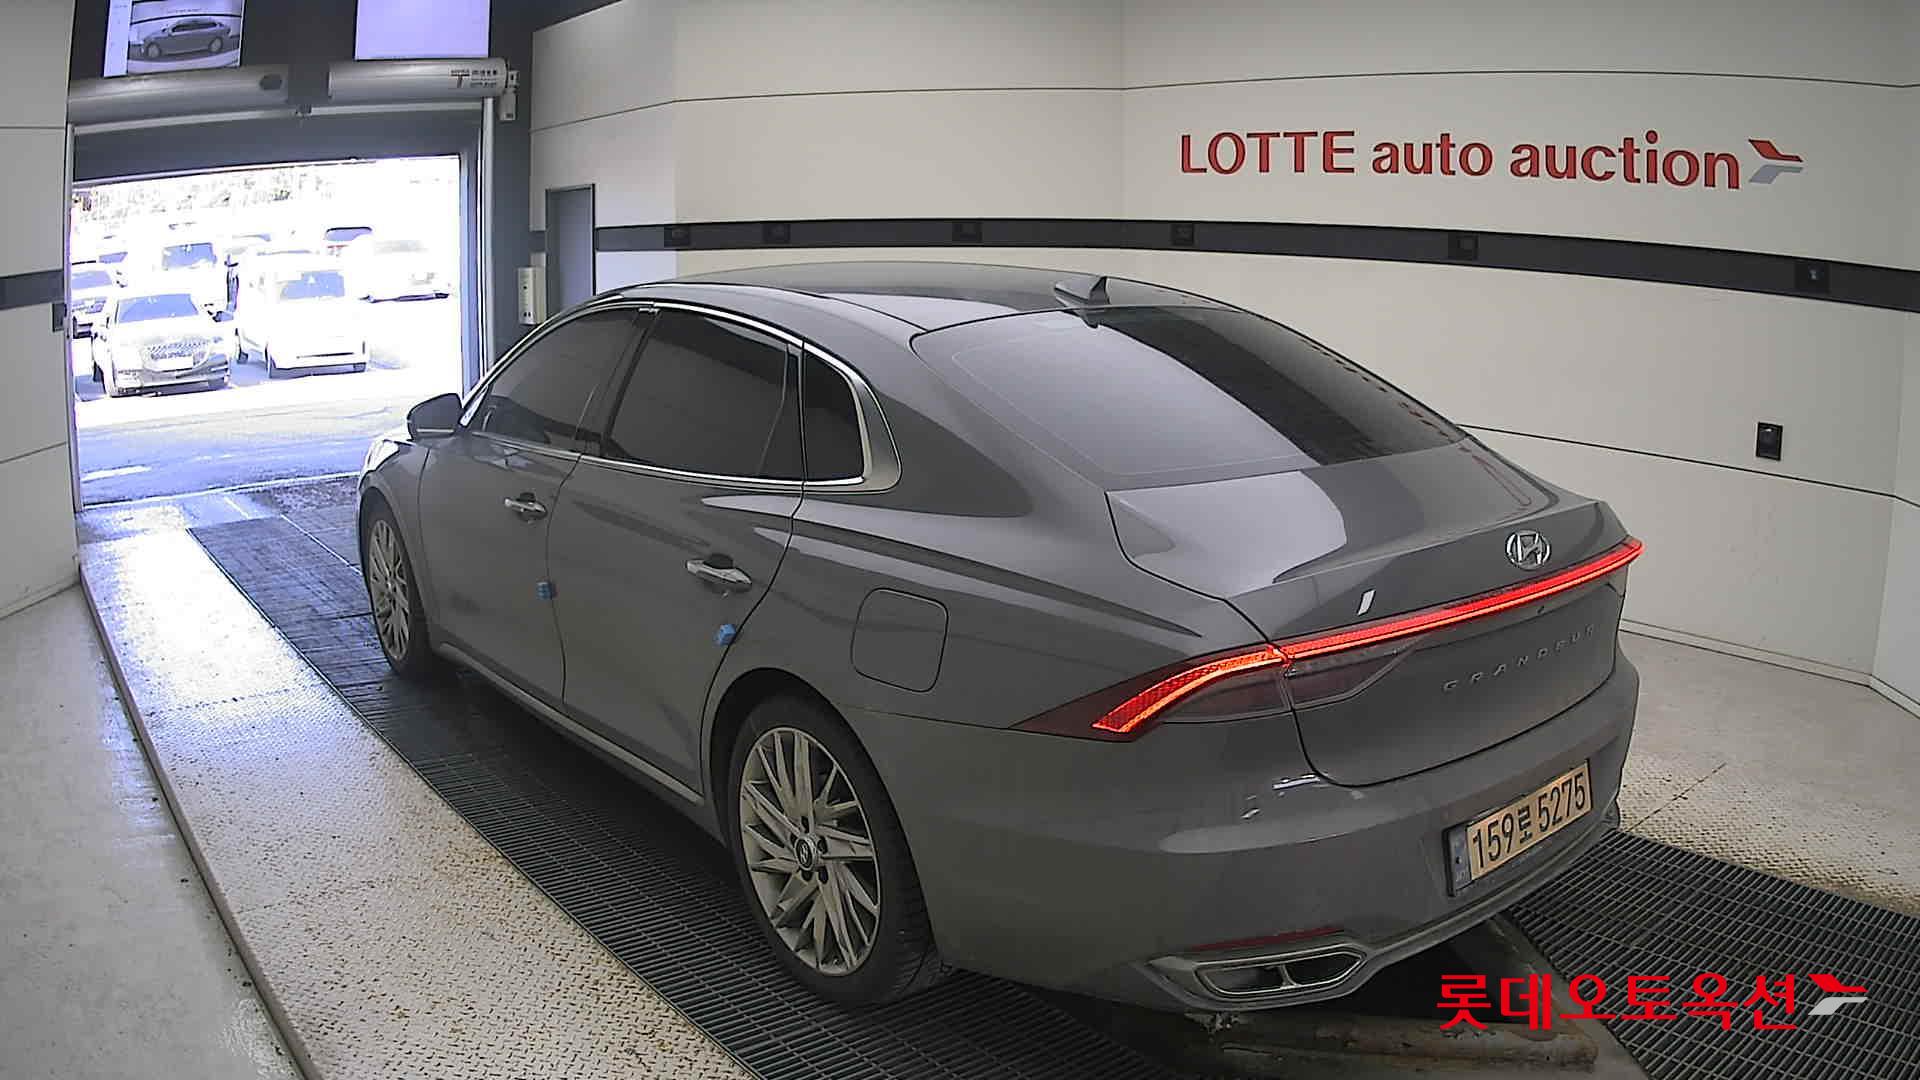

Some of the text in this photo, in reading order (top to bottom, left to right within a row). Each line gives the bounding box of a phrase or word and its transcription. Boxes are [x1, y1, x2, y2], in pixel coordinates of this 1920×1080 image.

[1181, 130, 1741, 189] LOTTE auto auction
[1537, 772, 1586, 832] 5275
